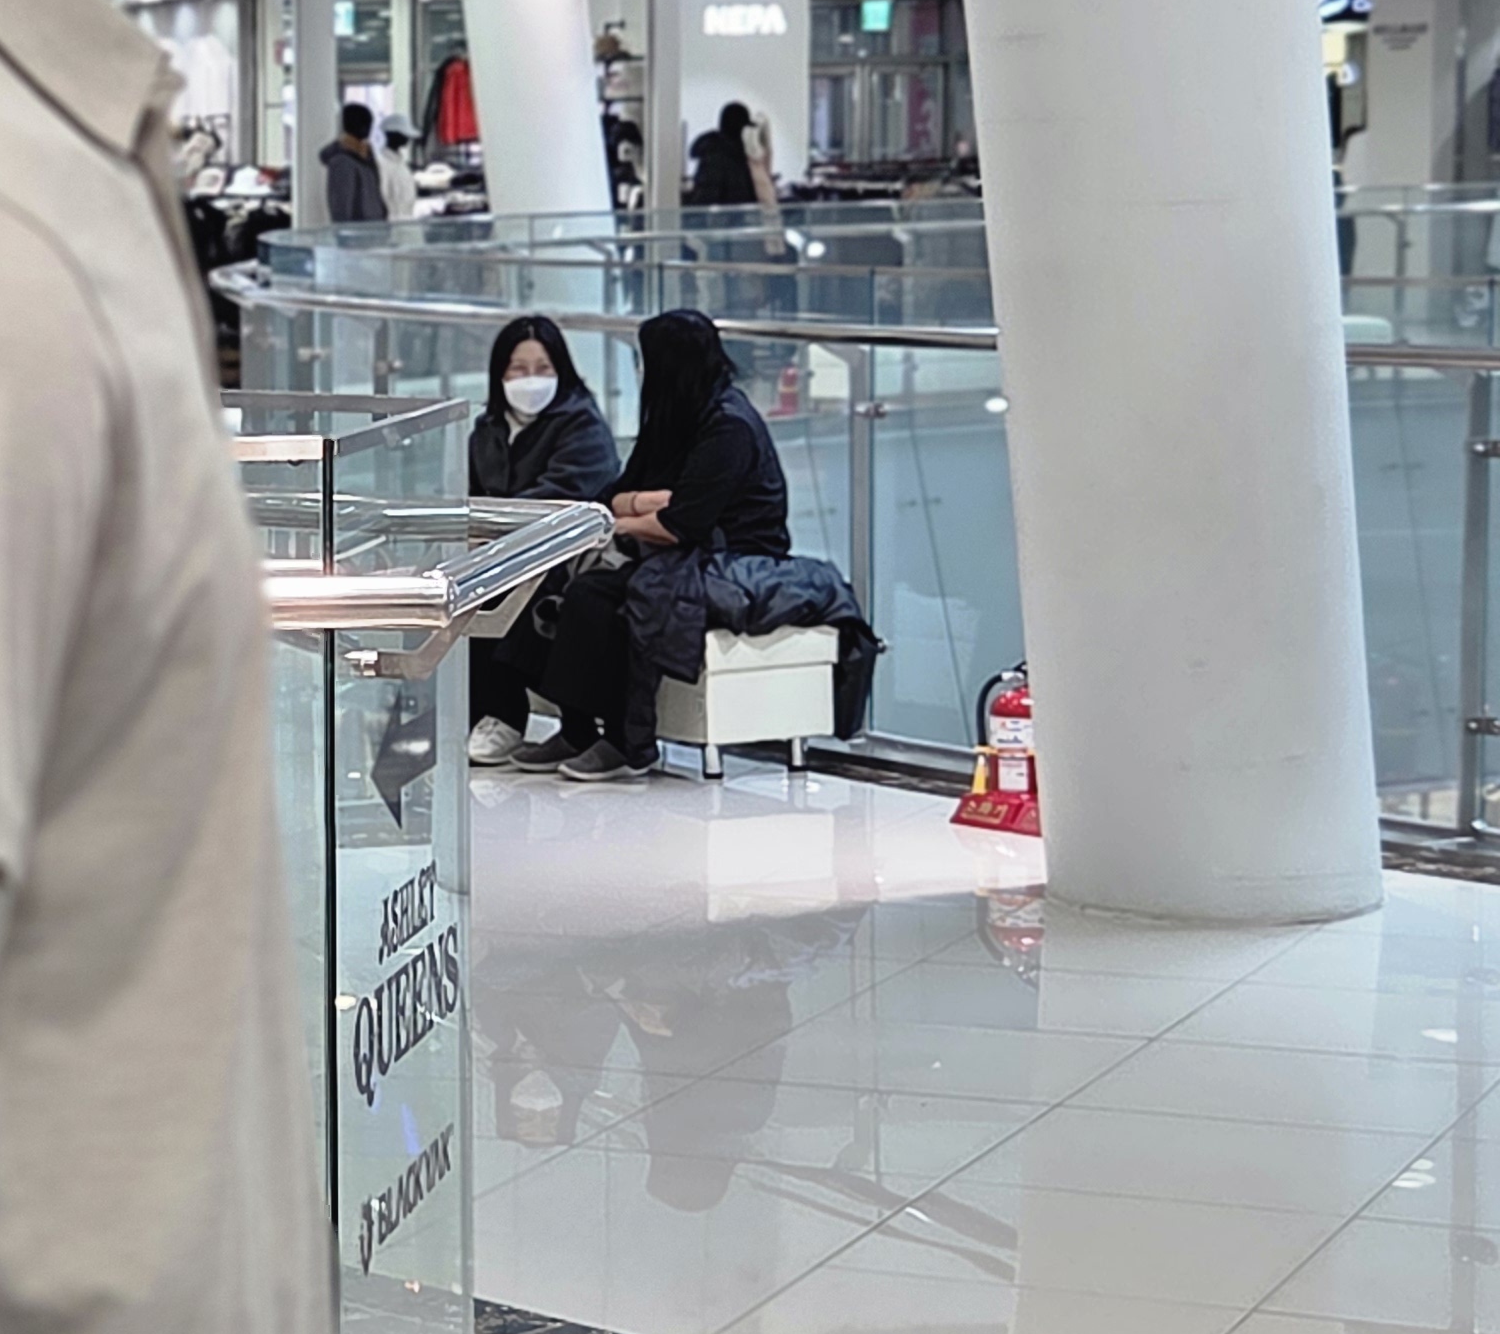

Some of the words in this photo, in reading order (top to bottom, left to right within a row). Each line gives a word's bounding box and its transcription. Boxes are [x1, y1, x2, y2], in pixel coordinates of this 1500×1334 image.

[703, 4, 787, 35] NEPA
[378, 859, 437, 965] ASHLEY
[353, 923, 460, 1107] QUEENS
